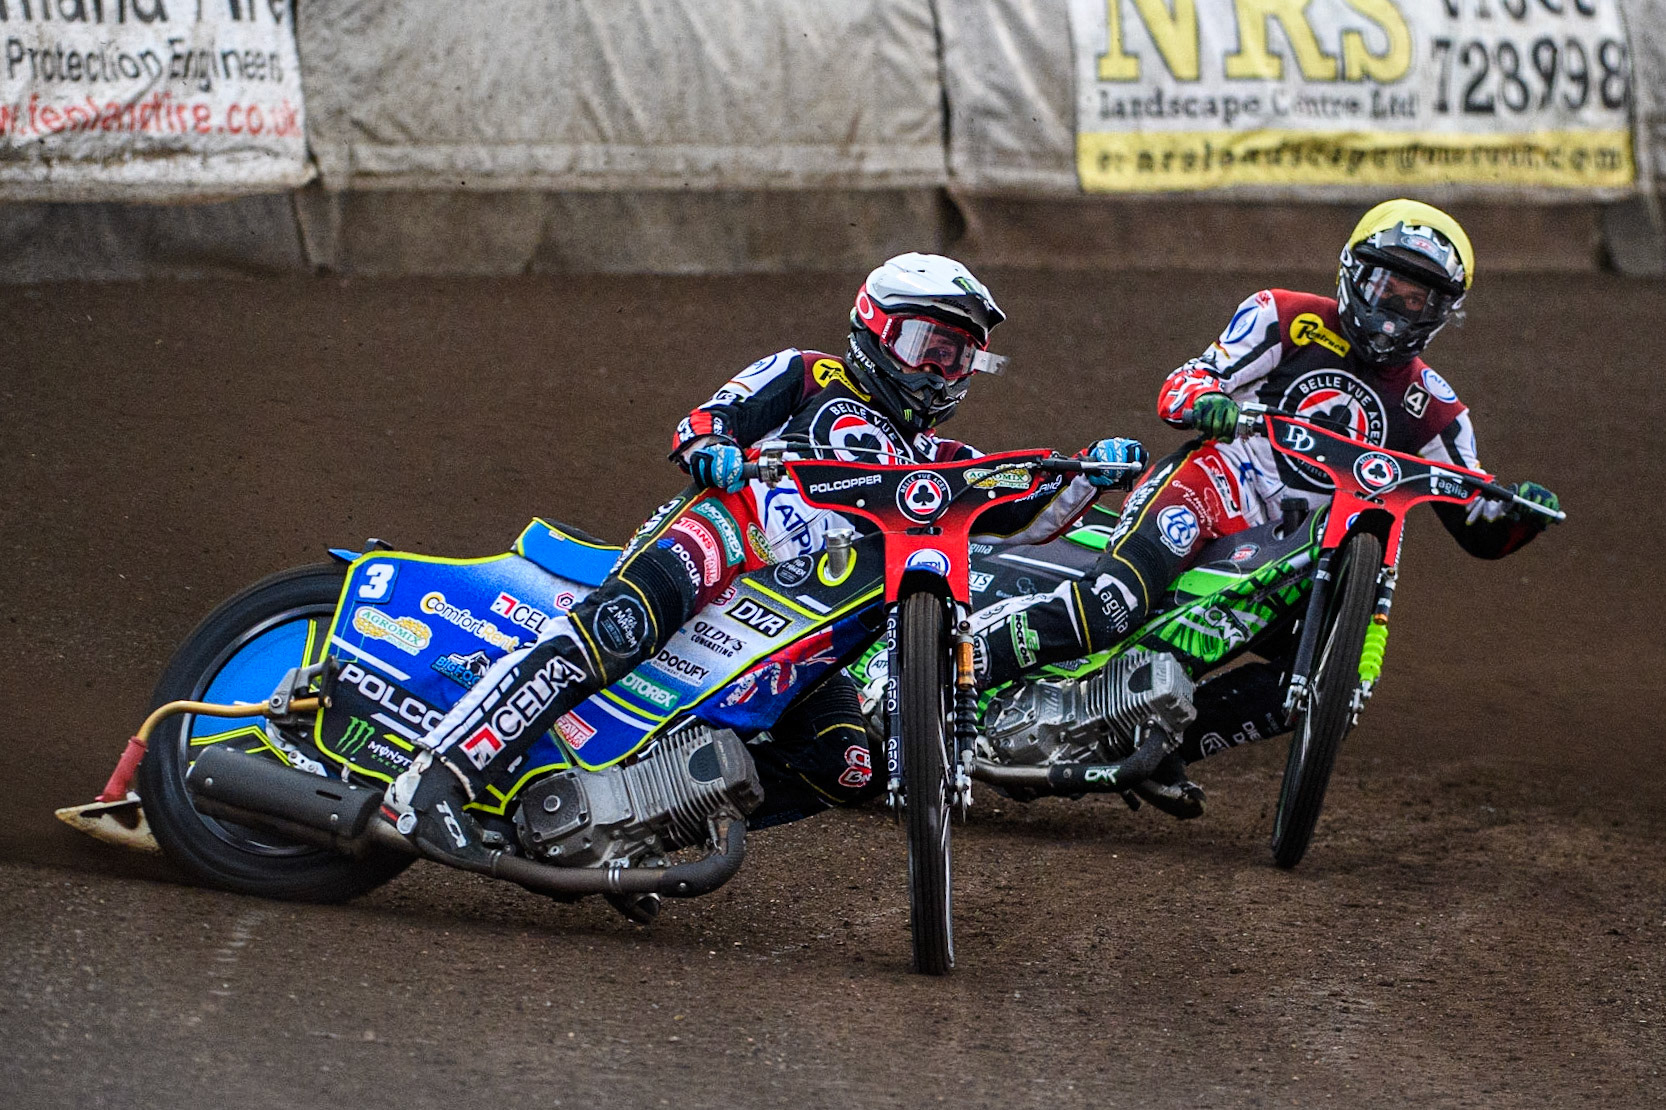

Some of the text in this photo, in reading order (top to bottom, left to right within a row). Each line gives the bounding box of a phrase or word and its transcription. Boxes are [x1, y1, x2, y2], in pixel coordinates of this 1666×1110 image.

[6, 37, 163, 82] Protection
[1431, 36, 1628, 114] 728998
[1298, 375, 1342, 395] BELLE
[1347, 382, 1372, 406] VUE
[1406, 391, 1425, 412] 4
[829, 402, 867, 419] BELLE
[873, 416, 898, 441] VUE
[809, 474, 882, 495] POLCOPPER
[899, 476, 916, 494] BELLE
[933, 477, 947, 492] ACES
[969, 470, 1026, 482] AGOMIX
[1438, 478, 1469, 499] agilia
[700, 501, 745, 559] MOTOREX
[969, 542, 993, 555] gilia
[358, 563, 395, 599] 3
[671, 542, 702, 595] DOCUF
[361, 610, 422, 646] AGROMIX
[513, 605, 548, 634] CEL
[730, 600, 786, 636] DVR
[1100, 590, 1129, 634] agilia
[690, 633, 734, 659] CONCRETING
[694, 620, 747, 652] OLDY'S
[656, 650, 710, 680] DOCUFY
[338, 663, 446, 732] POLCO
[494, 657, 585, 740] CELKA
[622, 672, 675, 708] OTOREX
[367, 740, 413, 767] MONST
